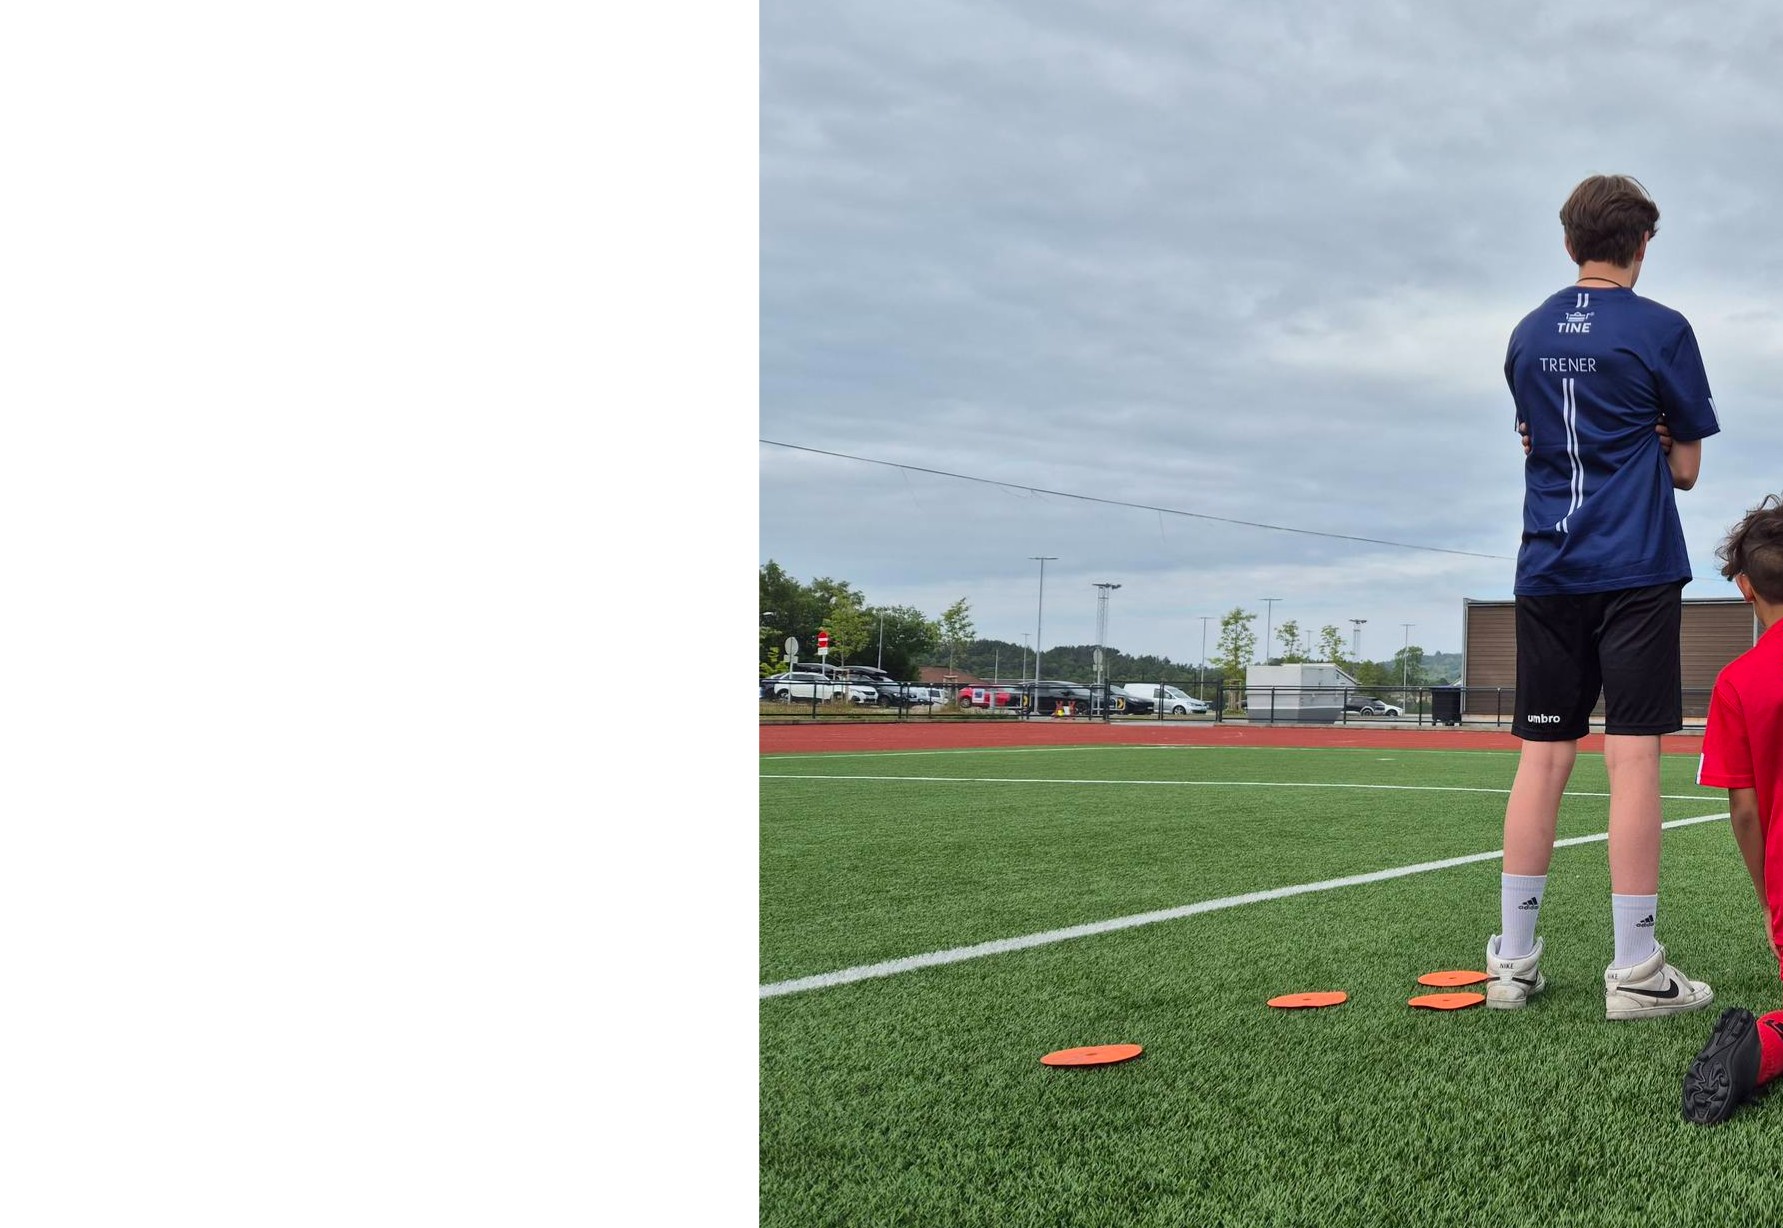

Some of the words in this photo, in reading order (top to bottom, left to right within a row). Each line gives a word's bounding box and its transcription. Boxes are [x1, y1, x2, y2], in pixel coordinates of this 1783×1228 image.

[1557, 322, 1592, 333] TINE
[1539, 357, 1597, 372] TRENER
[1527, 713, 1561, 724] umbro
